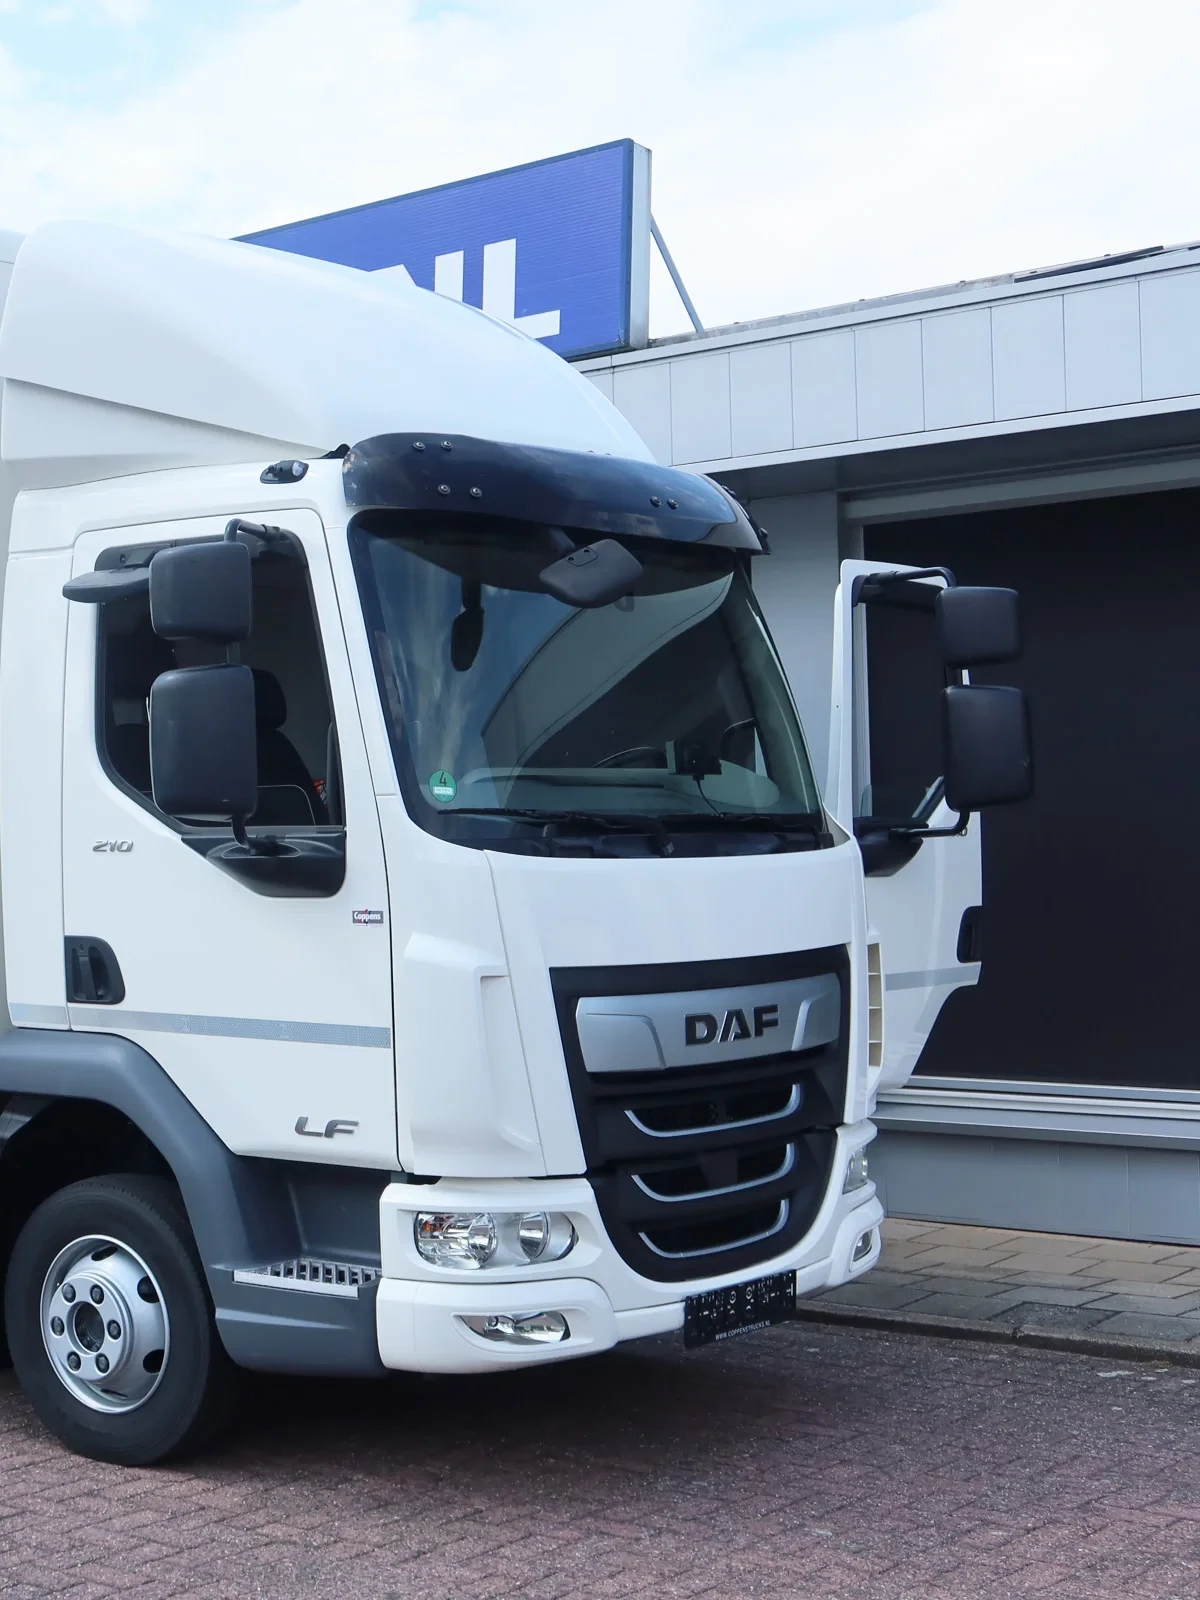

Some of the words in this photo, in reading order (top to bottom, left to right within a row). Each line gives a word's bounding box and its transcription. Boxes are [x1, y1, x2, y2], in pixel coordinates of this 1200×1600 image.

[439, 771, 448, 787] 4
[92, 839, 134, 853] 210
[353, 911, 381, 923] Coppens
[684, 1003, 779, 1047] DAF
[294, 1116, 359, 1139] LF
